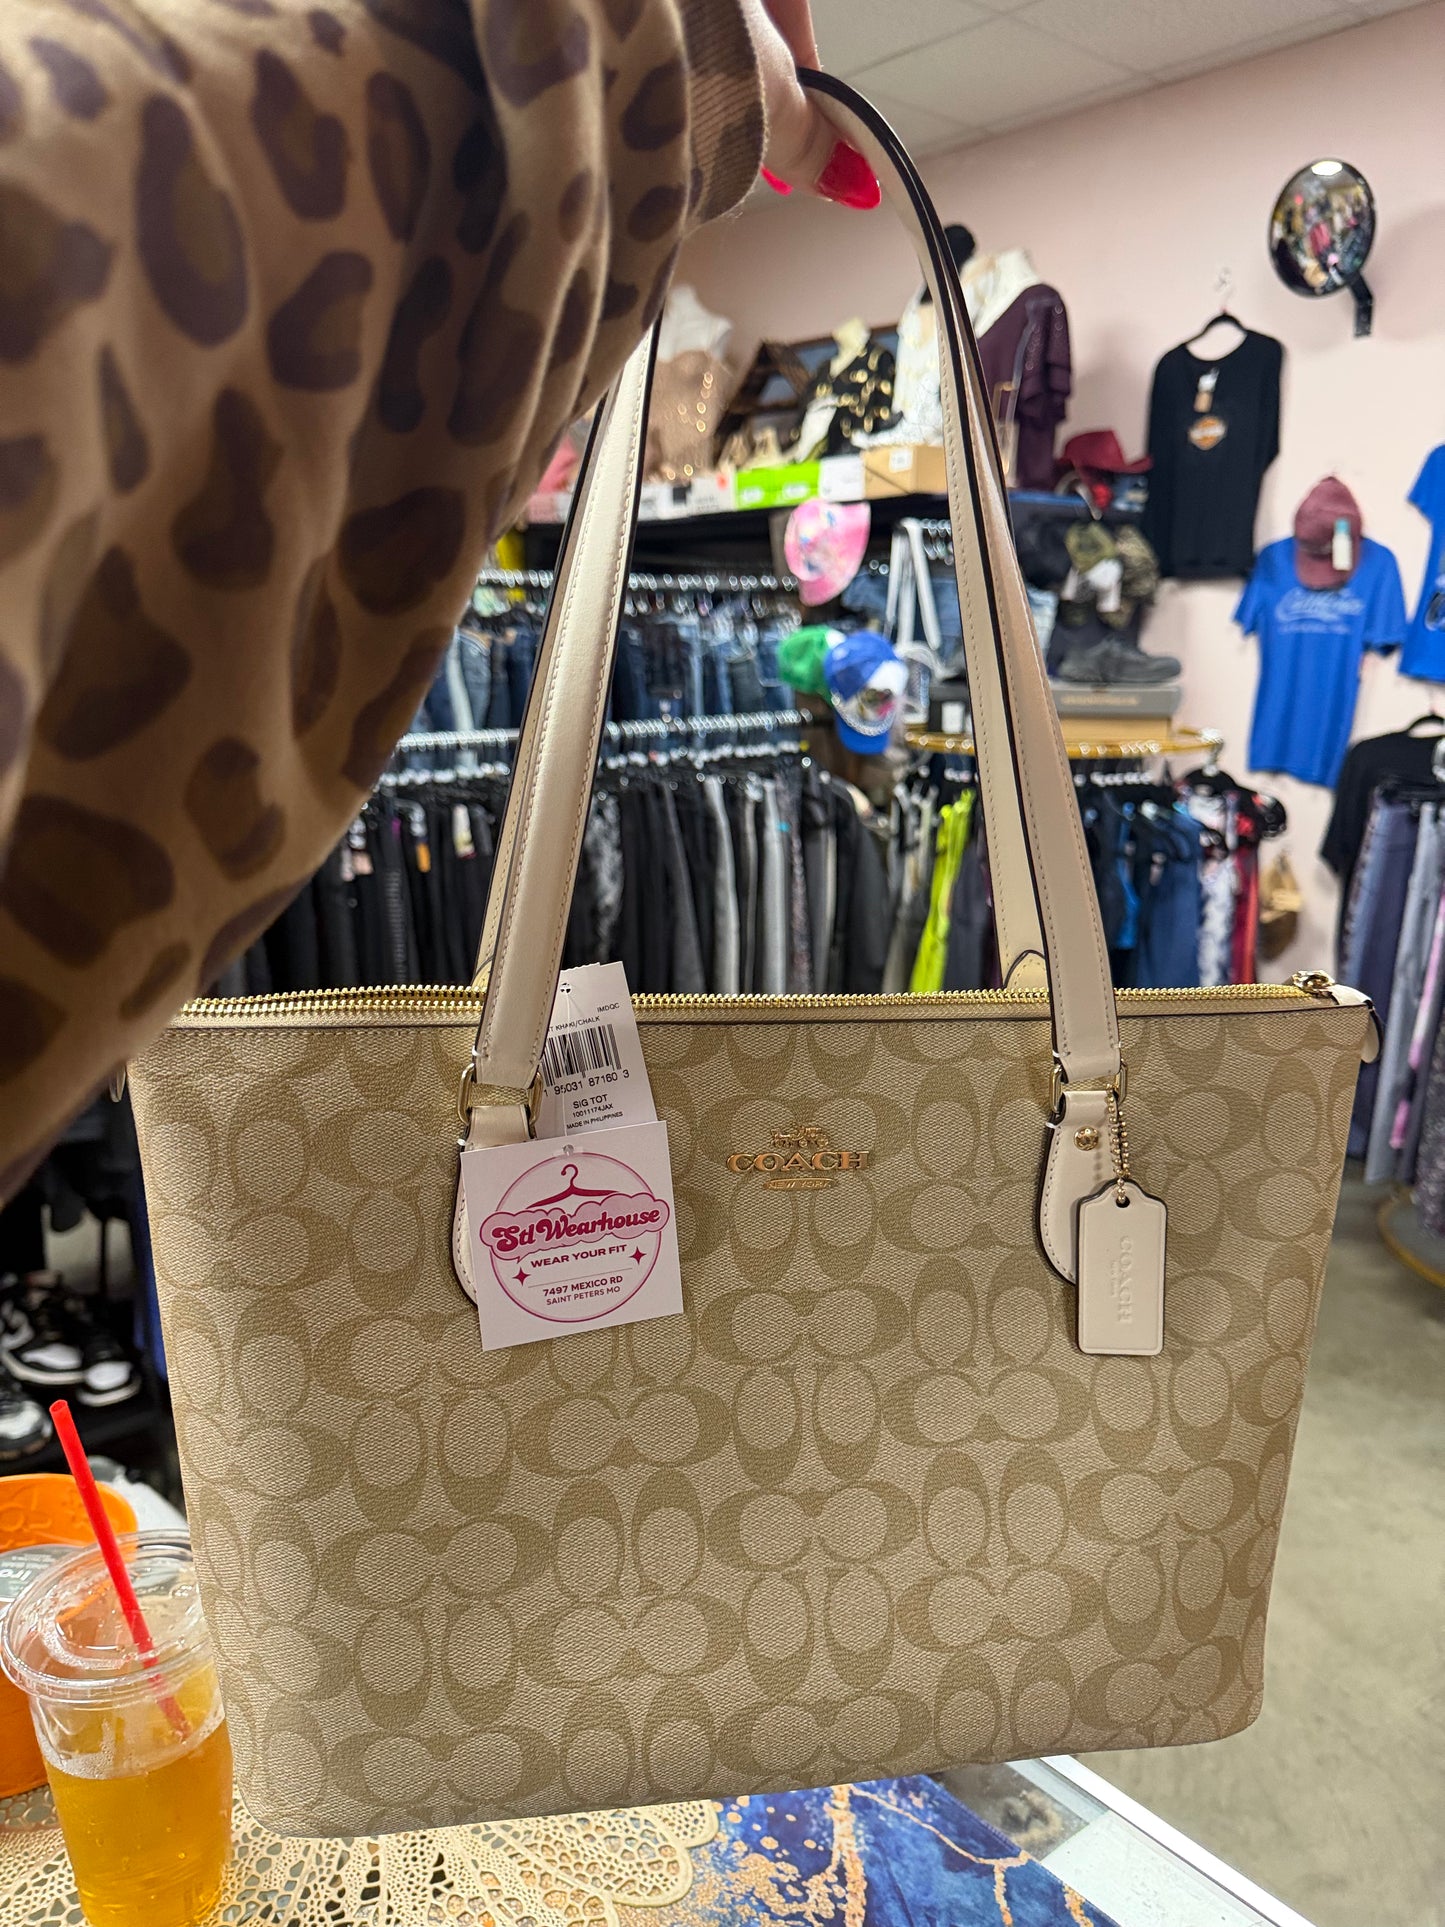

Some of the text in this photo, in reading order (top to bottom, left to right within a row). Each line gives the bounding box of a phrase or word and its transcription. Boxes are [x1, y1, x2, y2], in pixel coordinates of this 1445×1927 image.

[556, 1015, 600, 1030] KHAKI/CHALK
[544, 1069, 630, 1097] 1 95031 87160 3
[573, 1094, 608, 1109] SIG TOT
[566, 1120, 583, 1130] MADE
[590, 1111, 623, 1124] PHILIPPINES
[726, 1151, 870, 1172] COACH
[492, 1209, 661, 1252] Stl Wearhouse
[530, 1244, 628, 1268] WEAR YOUR FIT
[543, 1275, 624, 1297] 7497 MEXICO RD
[1118, 1235, 1133, 1325] COACH
[546, 1286, 621, 1306] SAINT PETERS MO
